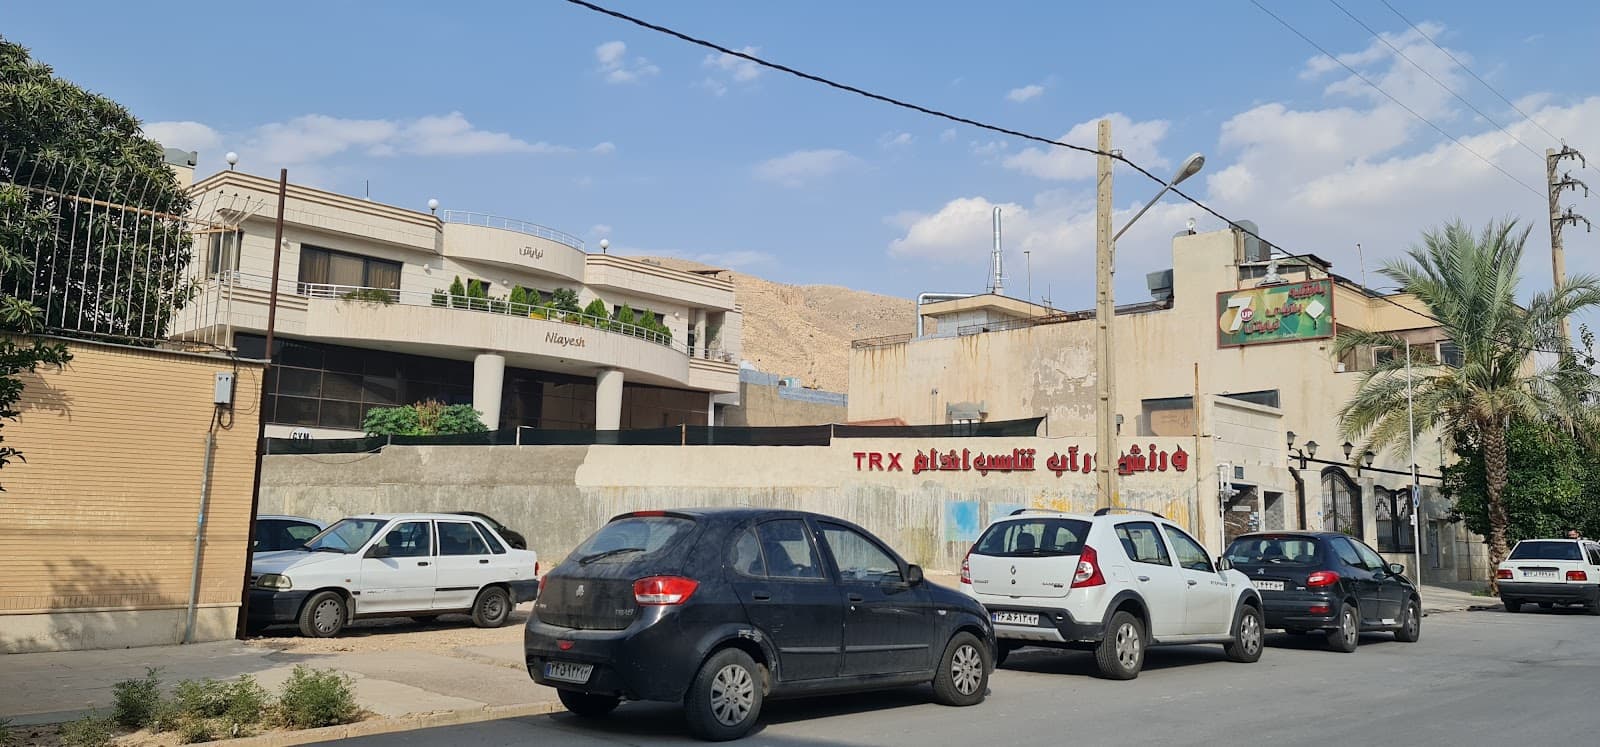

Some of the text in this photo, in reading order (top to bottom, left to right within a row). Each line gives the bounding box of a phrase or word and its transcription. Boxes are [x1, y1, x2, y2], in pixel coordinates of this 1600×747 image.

[545, 331, 586, 347] Niayesh
[853, 451, 904, 472] TRX
[912, 448, 971, 475] اندام
[973, 448, 1036, 476] تناسب
[1047, 445, 1079, 477] آب
[1118, 444, 1189, 475] ورزش
